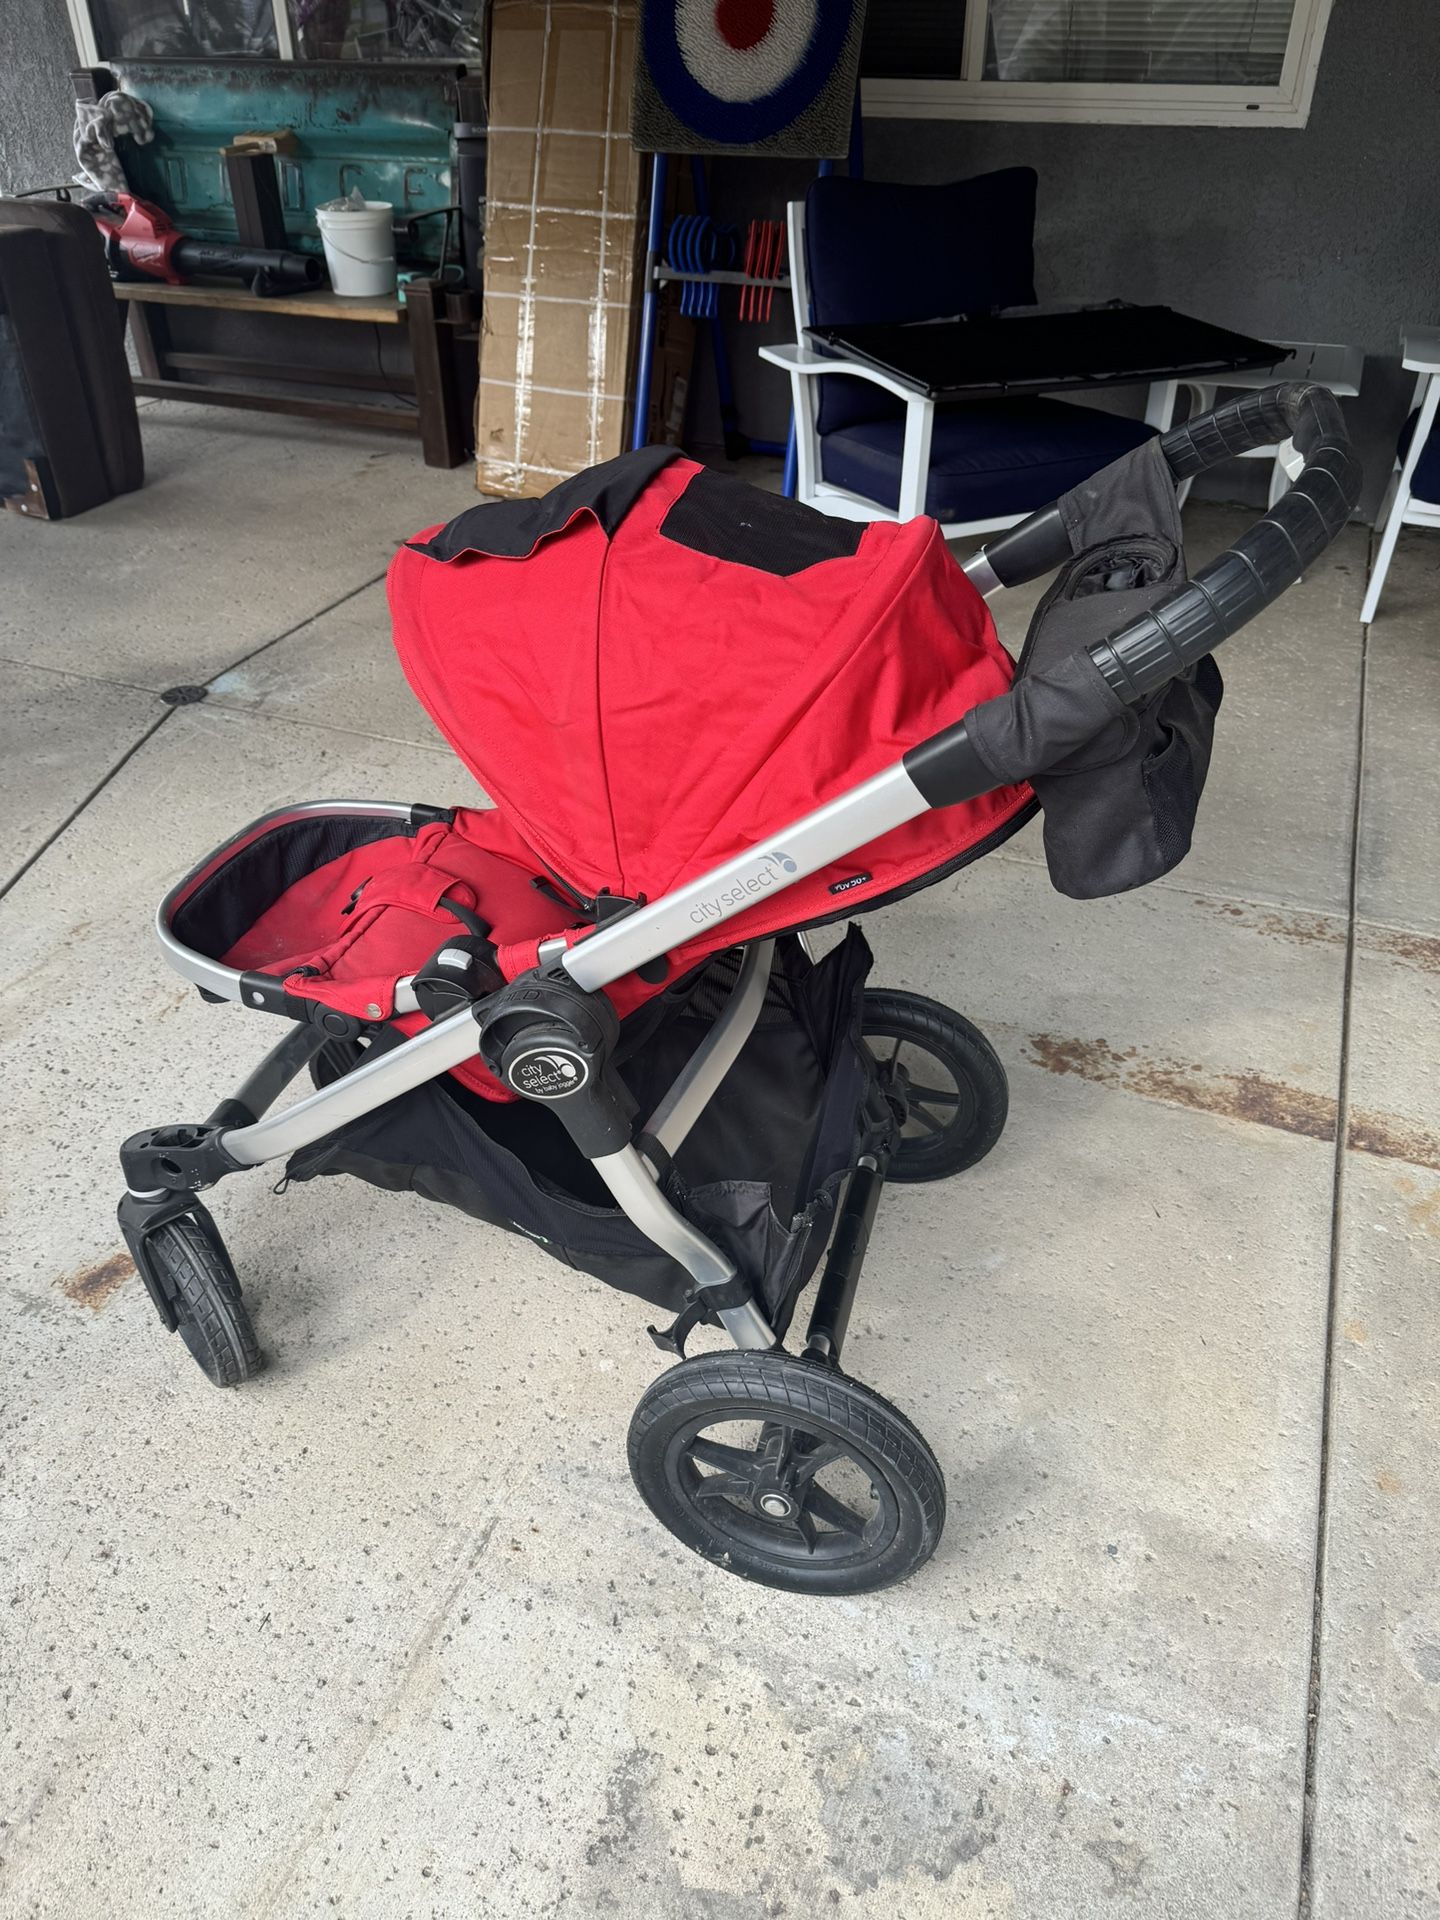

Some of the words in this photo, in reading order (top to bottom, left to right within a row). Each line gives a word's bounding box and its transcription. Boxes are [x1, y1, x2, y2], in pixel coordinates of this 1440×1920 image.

[690, 899, 723, 923] city
[721, 866, 778, 906] select
[521, 1064, 543, 1076] city
[543, 1084, 557, 1092] baby
[558, 1079, 576, 1089] jogger
